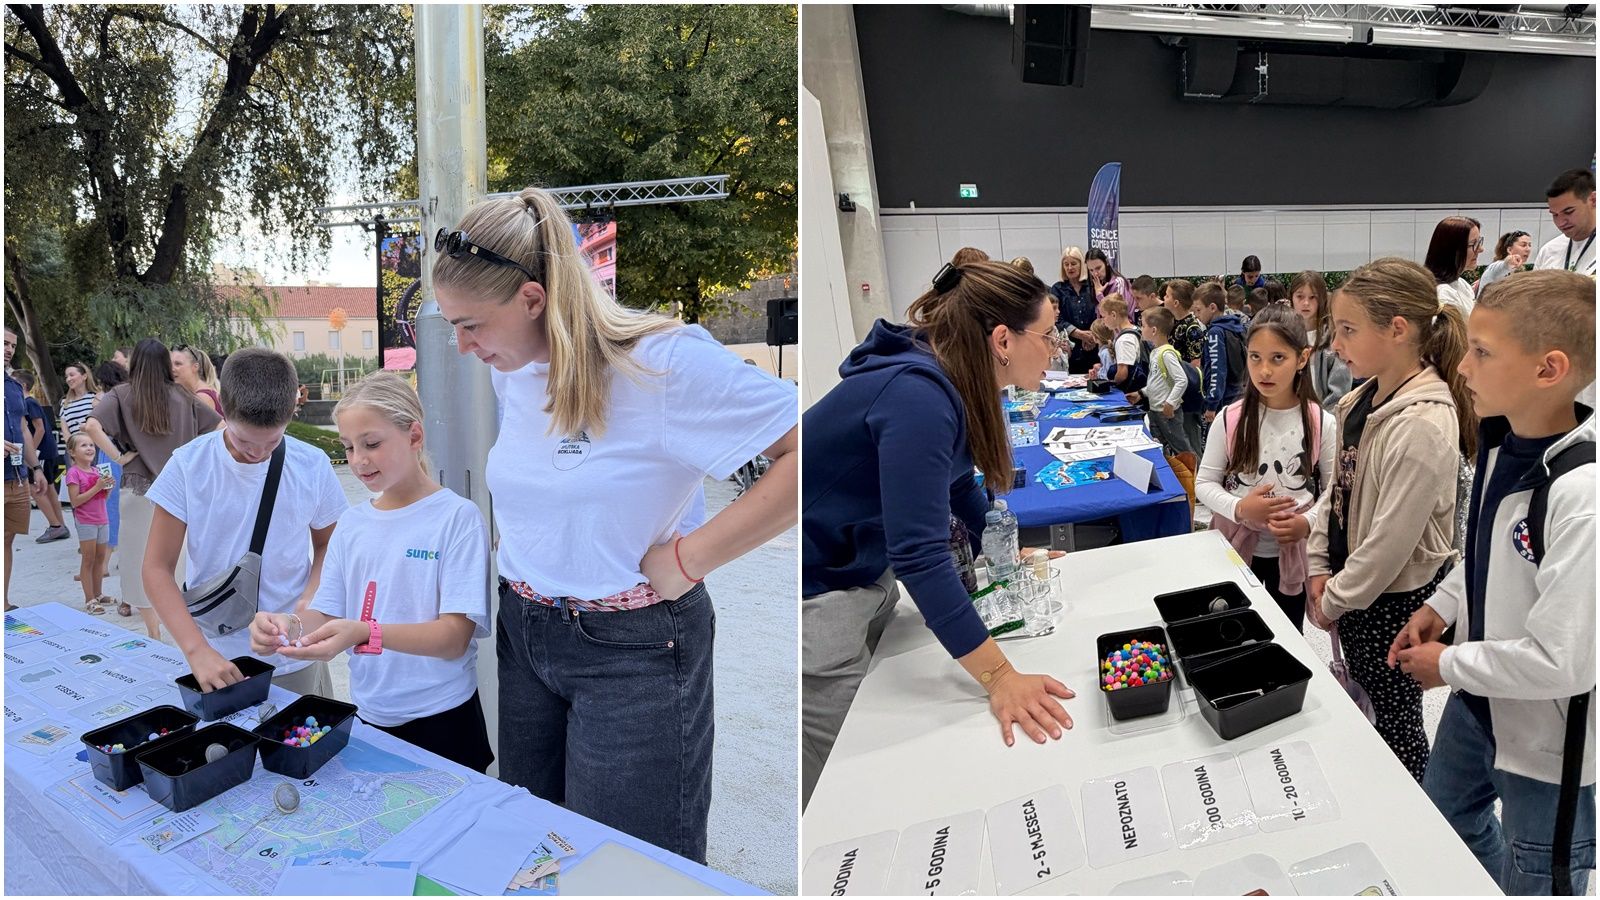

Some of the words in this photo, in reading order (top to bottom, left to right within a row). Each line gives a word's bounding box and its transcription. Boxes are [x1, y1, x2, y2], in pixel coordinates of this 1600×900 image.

[1091, 228, 1118, 240] SCIENCE
[1091, 239, 1109, 249] COMES
[1209, 334, 1218, 369] NIKE
[1270, 748, 1292, 784] GODINA
[1194, 765, 1216, 806] GODINA
[1283, 785, 1299, 800] 20
[1022, 799, 1045, 851] MJESECA
[1114, 780, 1138, 850] NEPOZNATO
[1292, 807, 1306, 822] 10
[928, 825, 951, 877] GODINA
[1033, 850, 1046, 861] 5
[830, 847, 860, 896] GODINA
[925, 878, 941, 890] 5
[1037, 867, 1051, 879] 2
